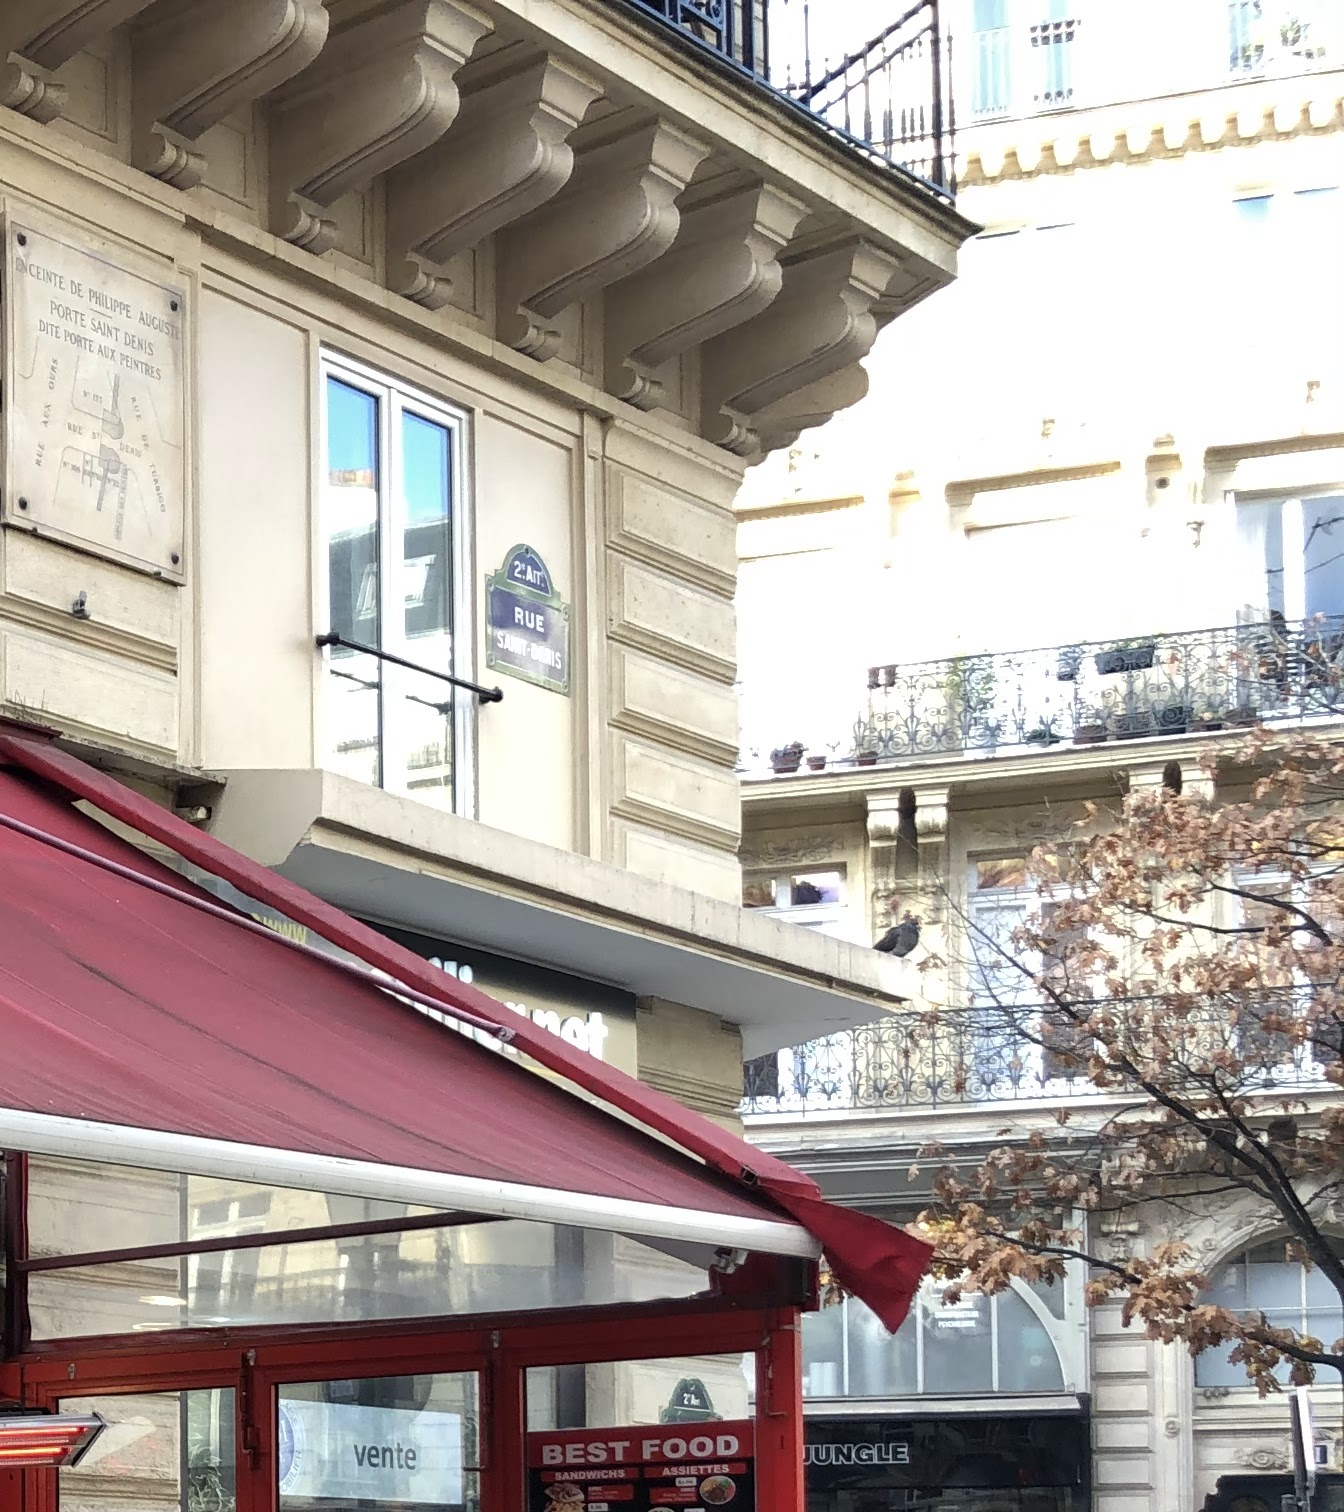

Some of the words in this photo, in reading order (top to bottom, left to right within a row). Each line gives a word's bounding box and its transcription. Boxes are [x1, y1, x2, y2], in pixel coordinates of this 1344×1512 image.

[15, 256, 66, 291] ENCEINTE
[70, 279, 85, 299] DE
[88, 287, 132, 320] PHILIPPE
[50, 299, 87, 329] PORTE
[90, 317, 121, 342] SAINT
[124, 331, 154, 357] DENIS
[38, 318, 61, 340] DITE
[63, 329, 95, 353] PORTE
[97, 343, 117, 364] AUX
[119, 352, 162, 382] PEINTRES
[514, 606, 545, 633] RUE
[353, 1442, 417, 1471] vente
[542, 1440, 630, 1465] BEST
[642, 1435, 739, 1460] FOOD
[555, 1469, 626, 1481] SANDWICHS
[662, 1463, 730, 1476] ASSIETTES
